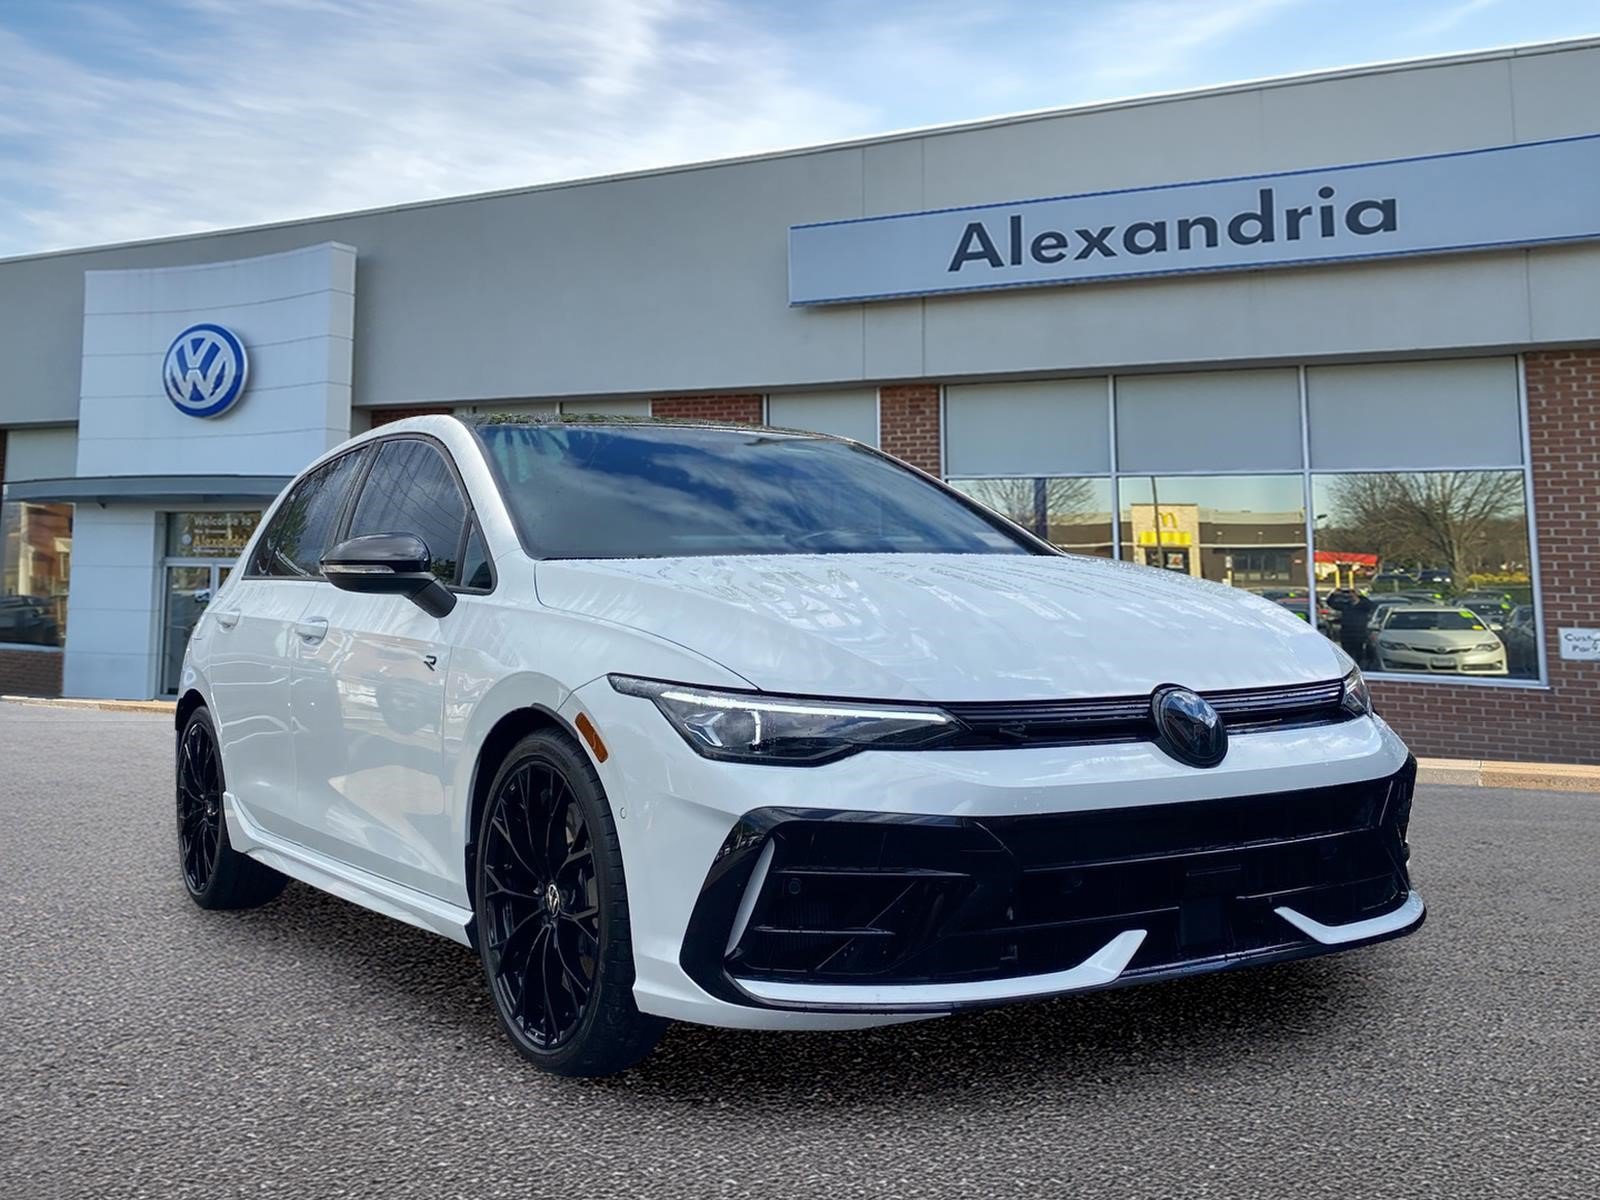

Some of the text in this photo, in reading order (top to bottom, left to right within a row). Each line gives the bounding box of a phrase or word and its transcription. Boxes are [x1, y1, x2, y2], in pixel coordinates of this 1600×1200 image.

[948, 186, 1398, 273] Alexandria
[165, 329, 239, 410] VW
[423, 654, 437, 672] R
